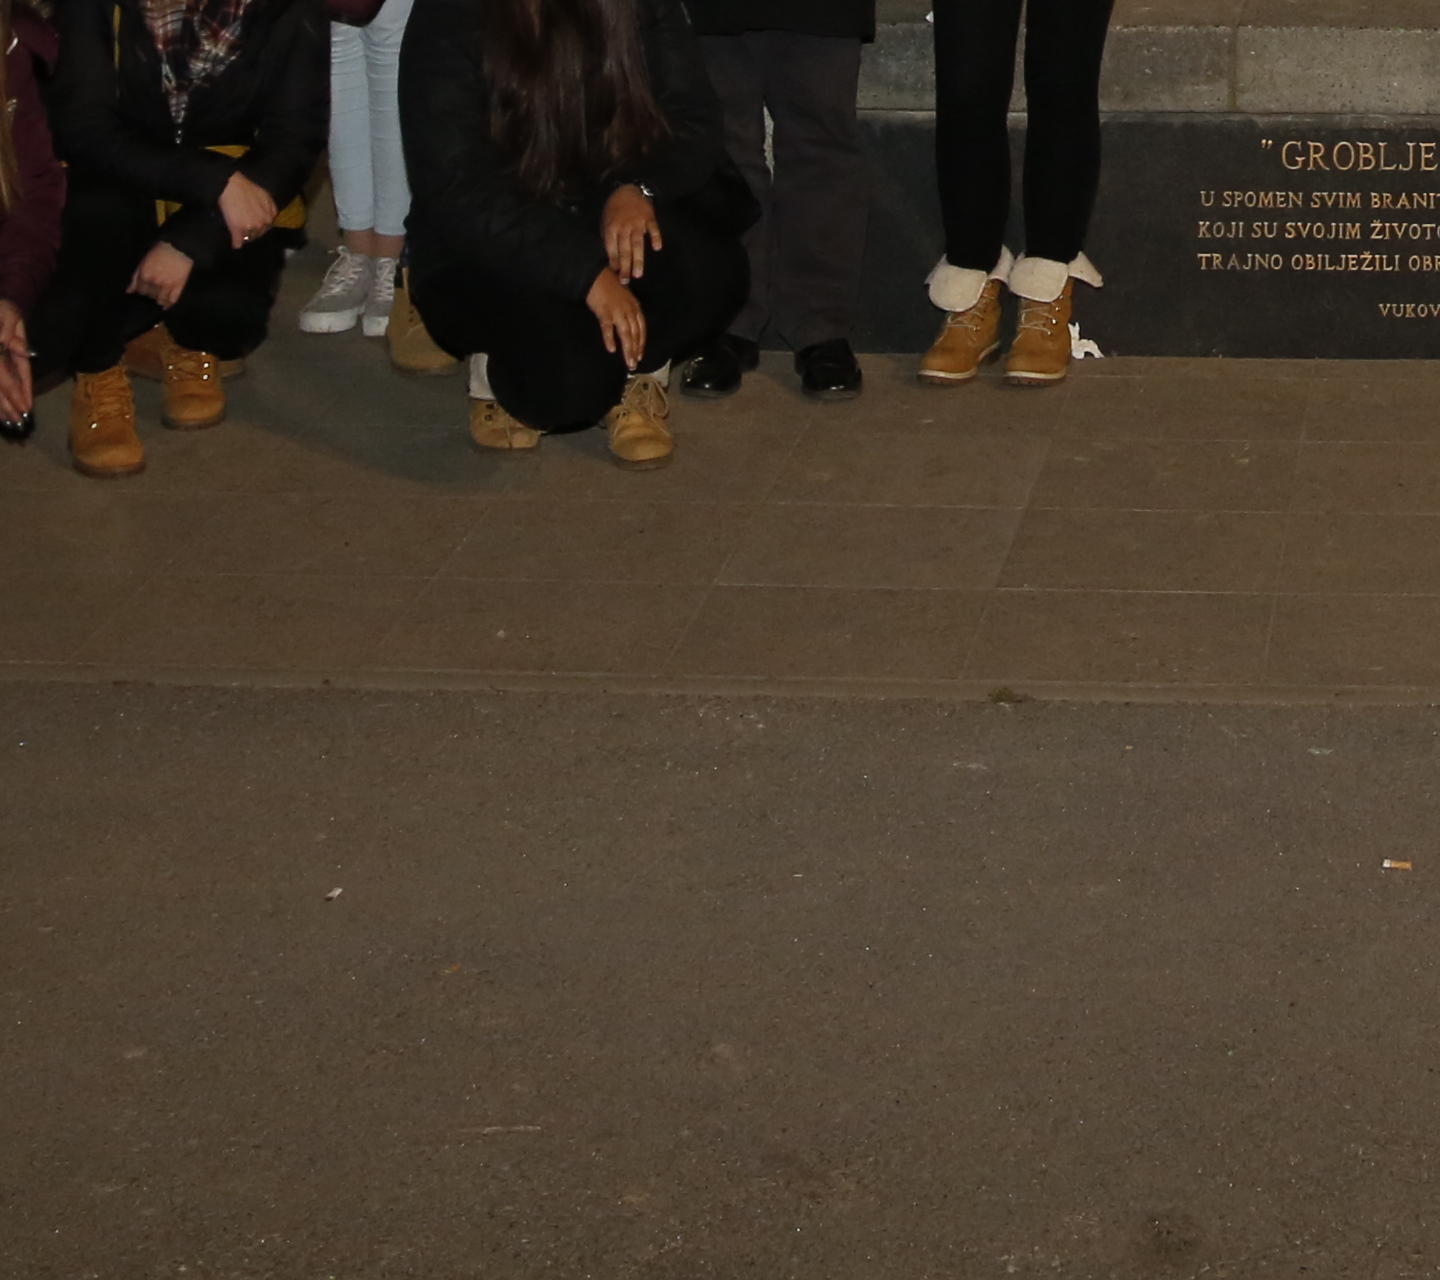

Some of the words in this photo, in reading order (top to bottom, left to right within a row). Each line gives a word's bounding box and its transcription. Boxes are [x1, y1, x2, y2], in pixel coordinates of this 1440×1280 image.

[1200, 191, 1215, 207] U
[1221, 191, 1303, 209] SPOMEN
[1310, 192, 1362, 209] SVIM
[1197, 220, 1244, 238] KOJI
[1251, 221, 1278, 239] SU
[1285, 222, 1362, 239] SVOJIM
[1197, 252, 1283, 271] TRAJNO
[1291, 251, 1400, 272] OBILJEŽILI
